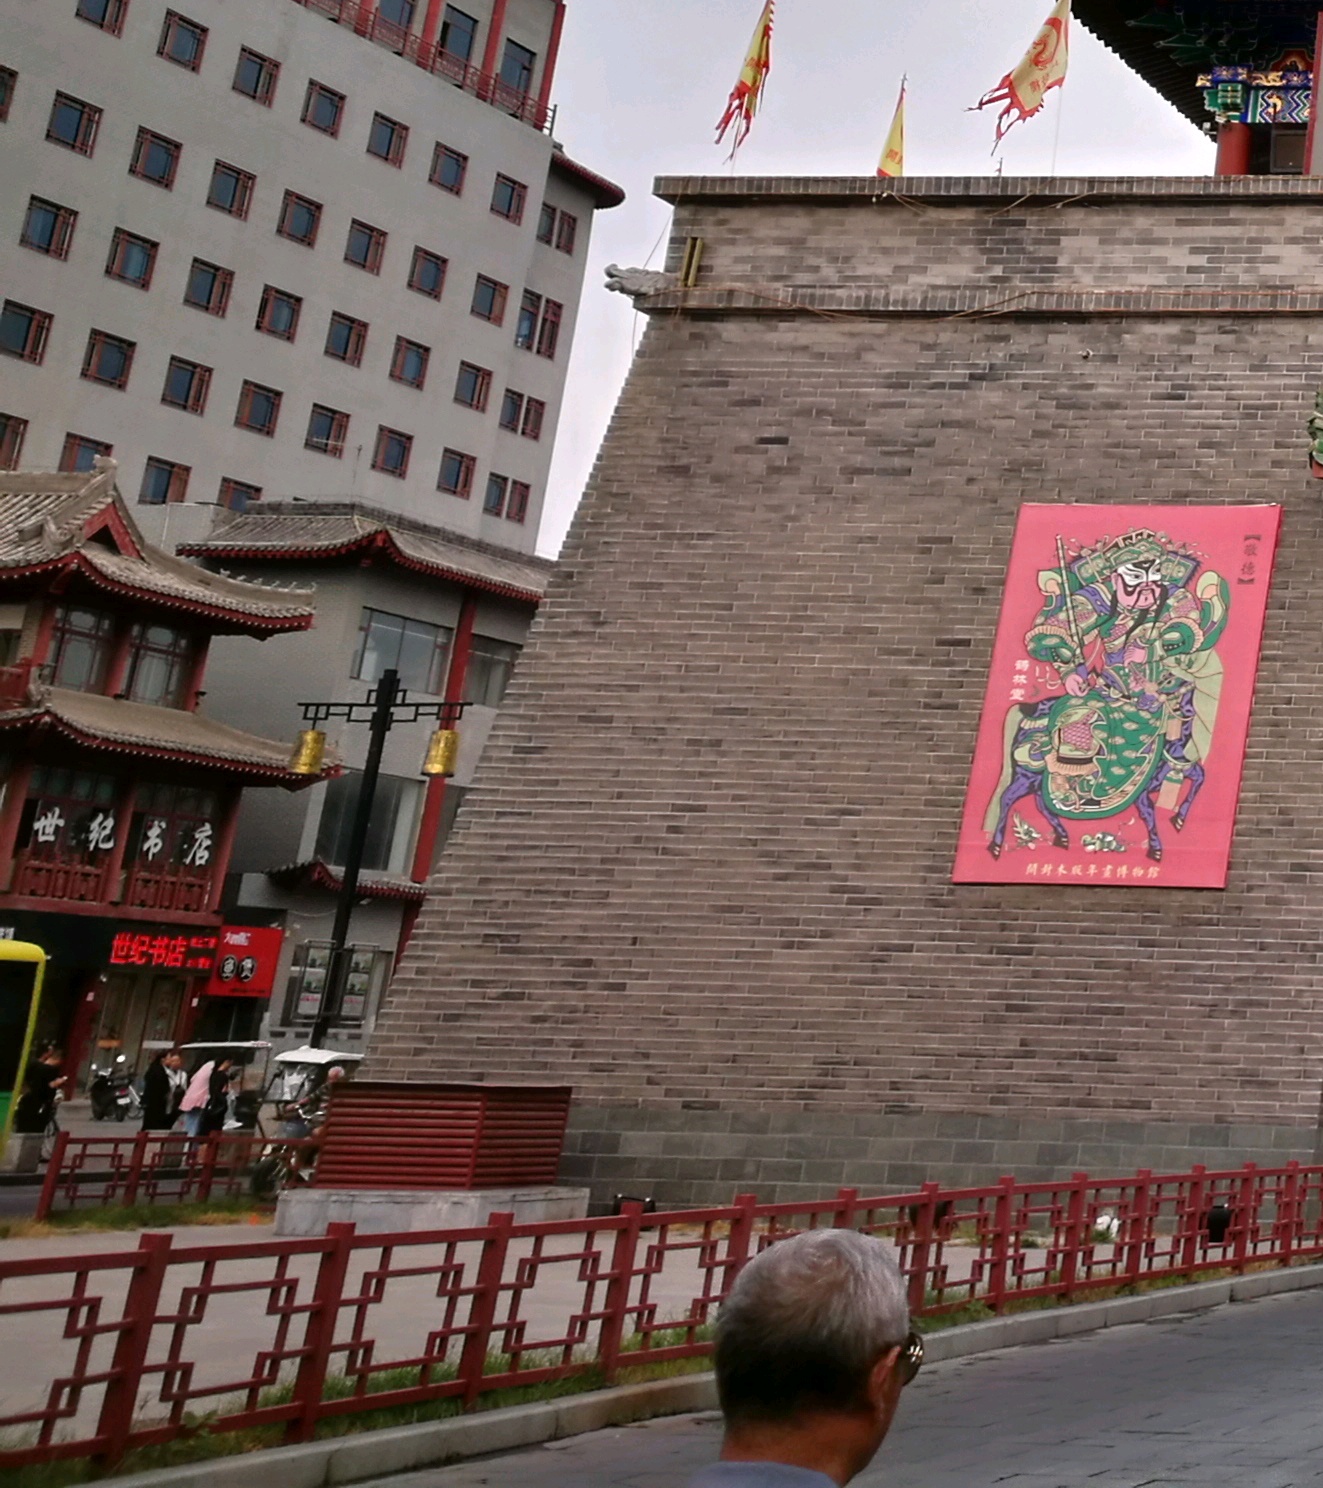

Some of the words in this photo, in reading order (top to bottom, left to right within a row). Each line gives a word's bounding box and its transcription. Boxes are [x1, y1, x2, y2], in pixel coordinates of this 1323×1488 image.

[33, 806, 215, 867] 世纪书店
[110, 932, 189, 968] 世纪书店
